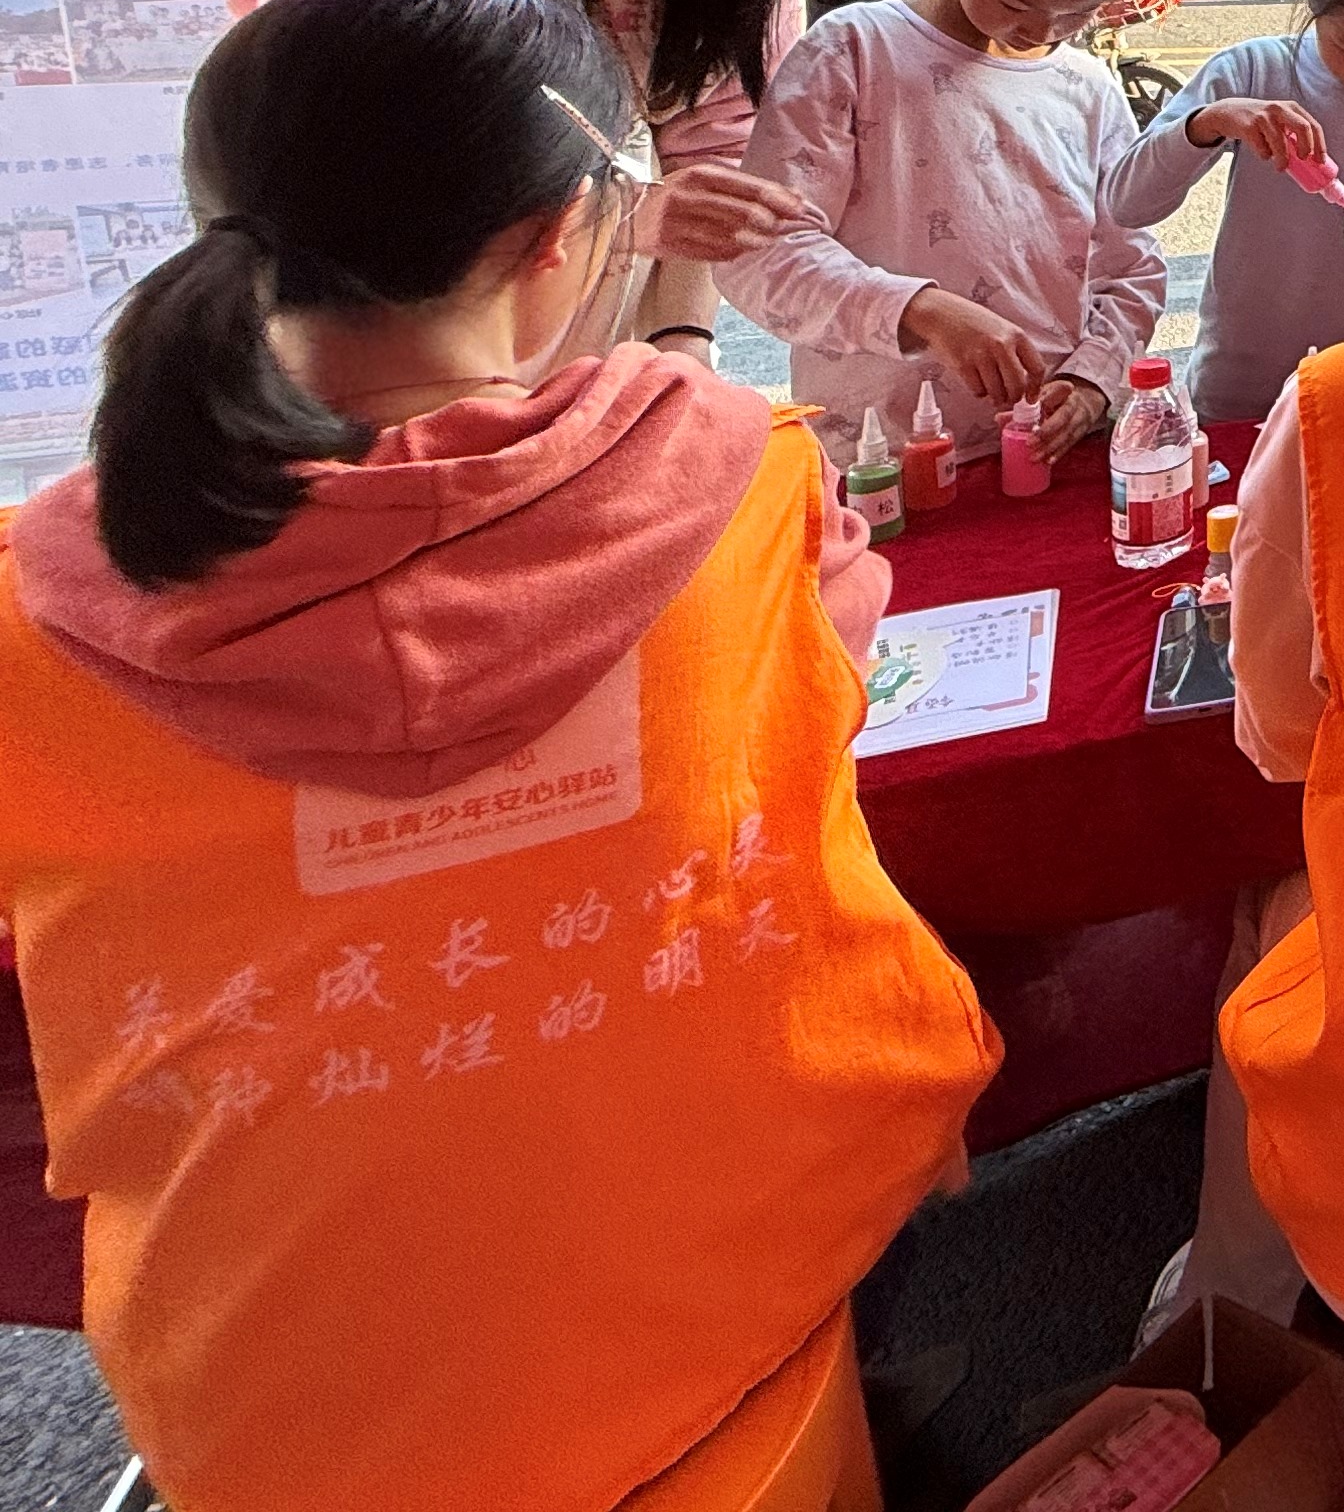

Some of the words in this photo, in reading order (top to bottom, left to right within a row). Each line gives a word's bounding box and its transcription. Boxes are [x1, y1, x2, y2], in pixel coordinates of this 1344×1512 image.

[324, 763, 619, 854] 儿童青少年安心驿站
